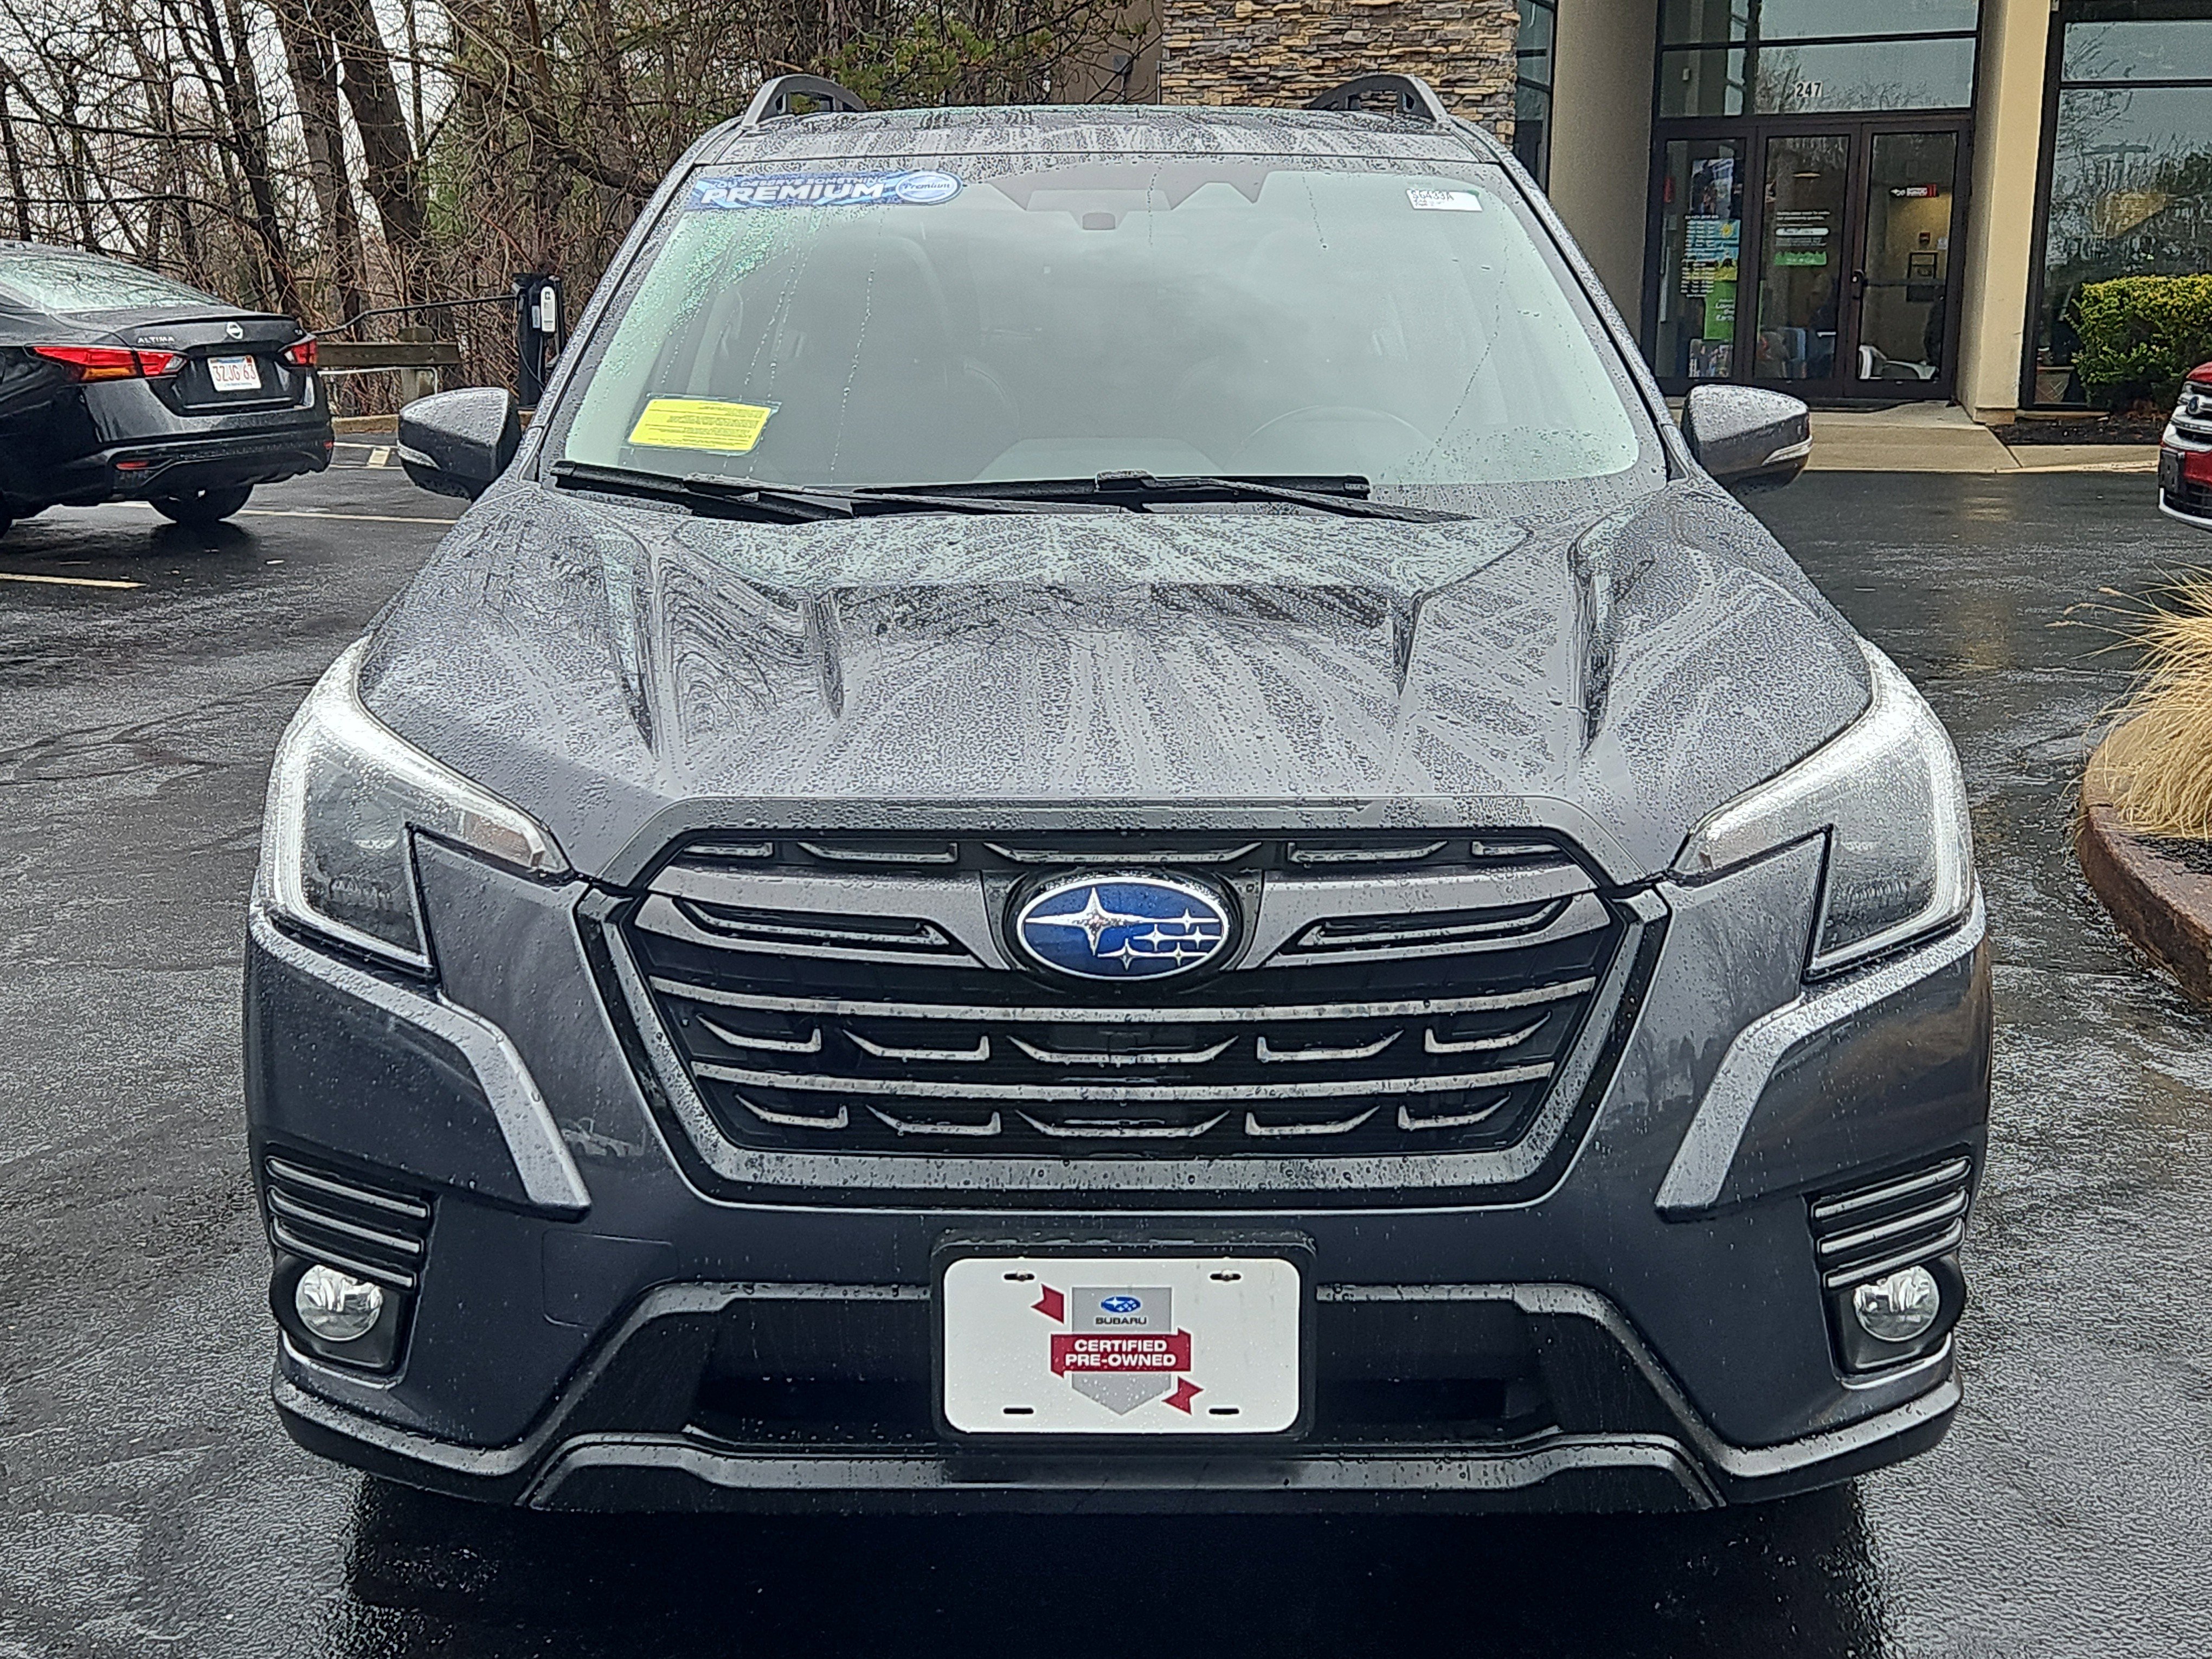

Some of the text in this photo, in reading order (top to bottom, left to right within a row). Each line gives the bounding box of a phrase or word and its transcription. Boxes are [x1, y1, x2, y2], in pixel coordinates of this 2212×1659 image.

[1797, 82, 1821, 97] 247
[701, 183, 884, 203] PREMIUM
[243, 364, 256, 380] 63
[1075, 1339, 1167, 1352] CERTIFIED
[1065, 1354, 1176, 1367] PRE-OWNED
